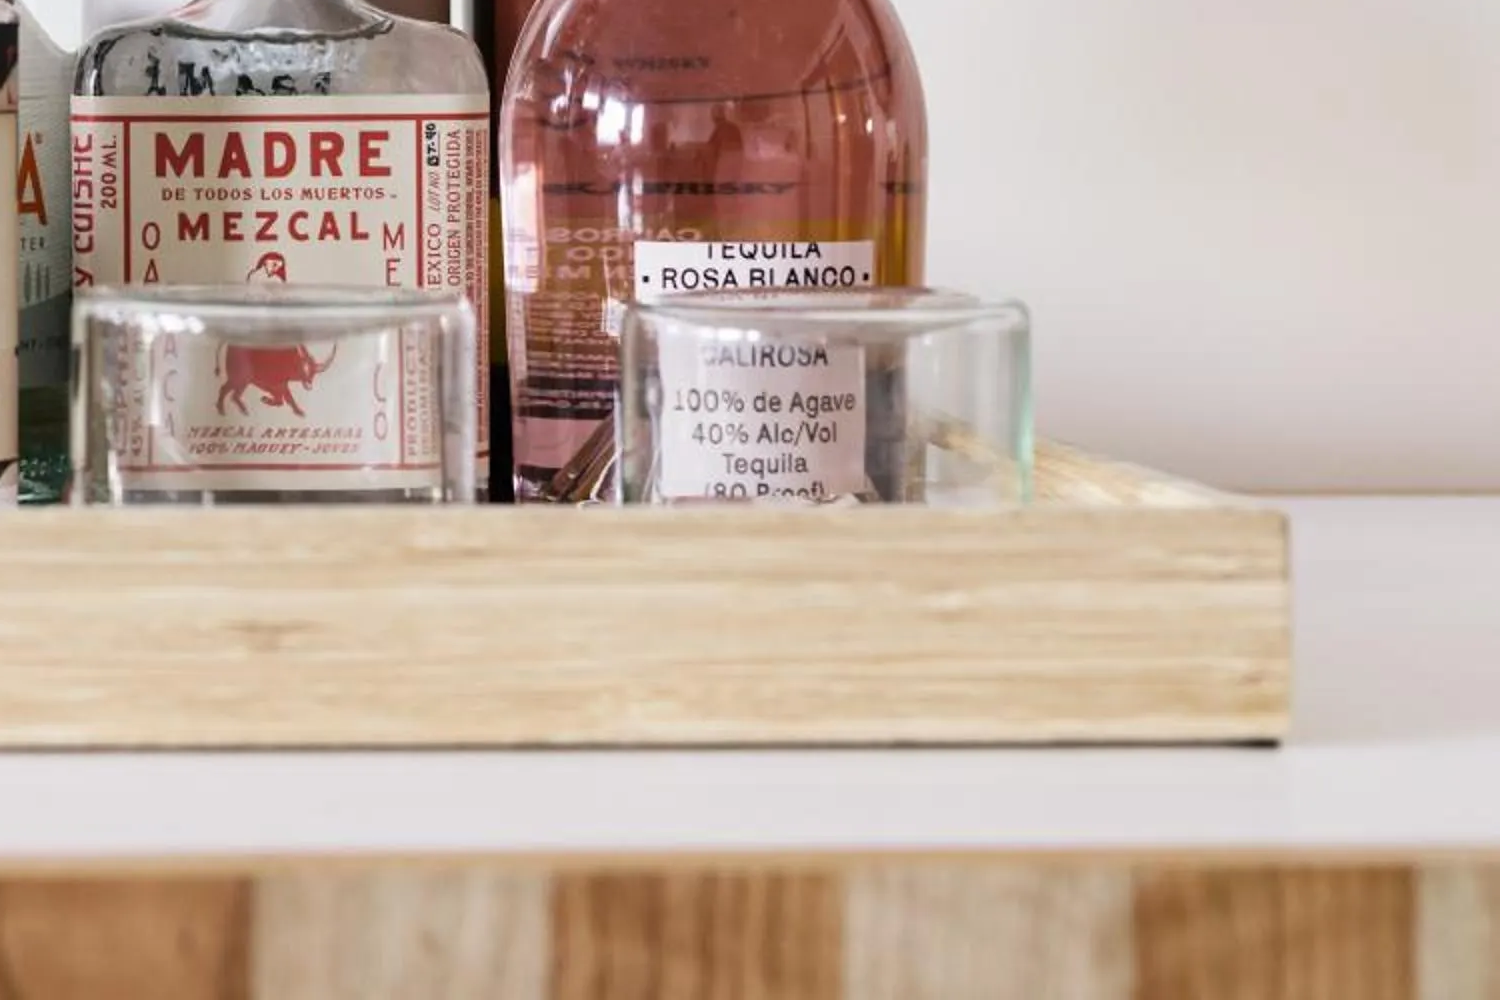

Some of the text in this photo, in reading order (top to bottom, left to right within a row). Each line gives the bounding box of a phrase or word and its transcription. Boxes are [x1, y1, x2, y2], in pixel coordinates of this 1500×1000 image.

[155, 130, 391, 178] MADRE
[162, 188, 185, 201] DE
[194, 187, 252, 201] TODOS
[260, 187, 293, 201] LOS
[447, 129, 461, 287] ORIGEN PROTEGIDA
[178, 210, 369, 242] MEZCAL
[662, 268, 739, 290] ROSA
[674, 388, 856, 418] 100% de Agave
[692, 421, 838, 446] 40% Alc/Vol
[722, 453, 809, 478] Tequila
